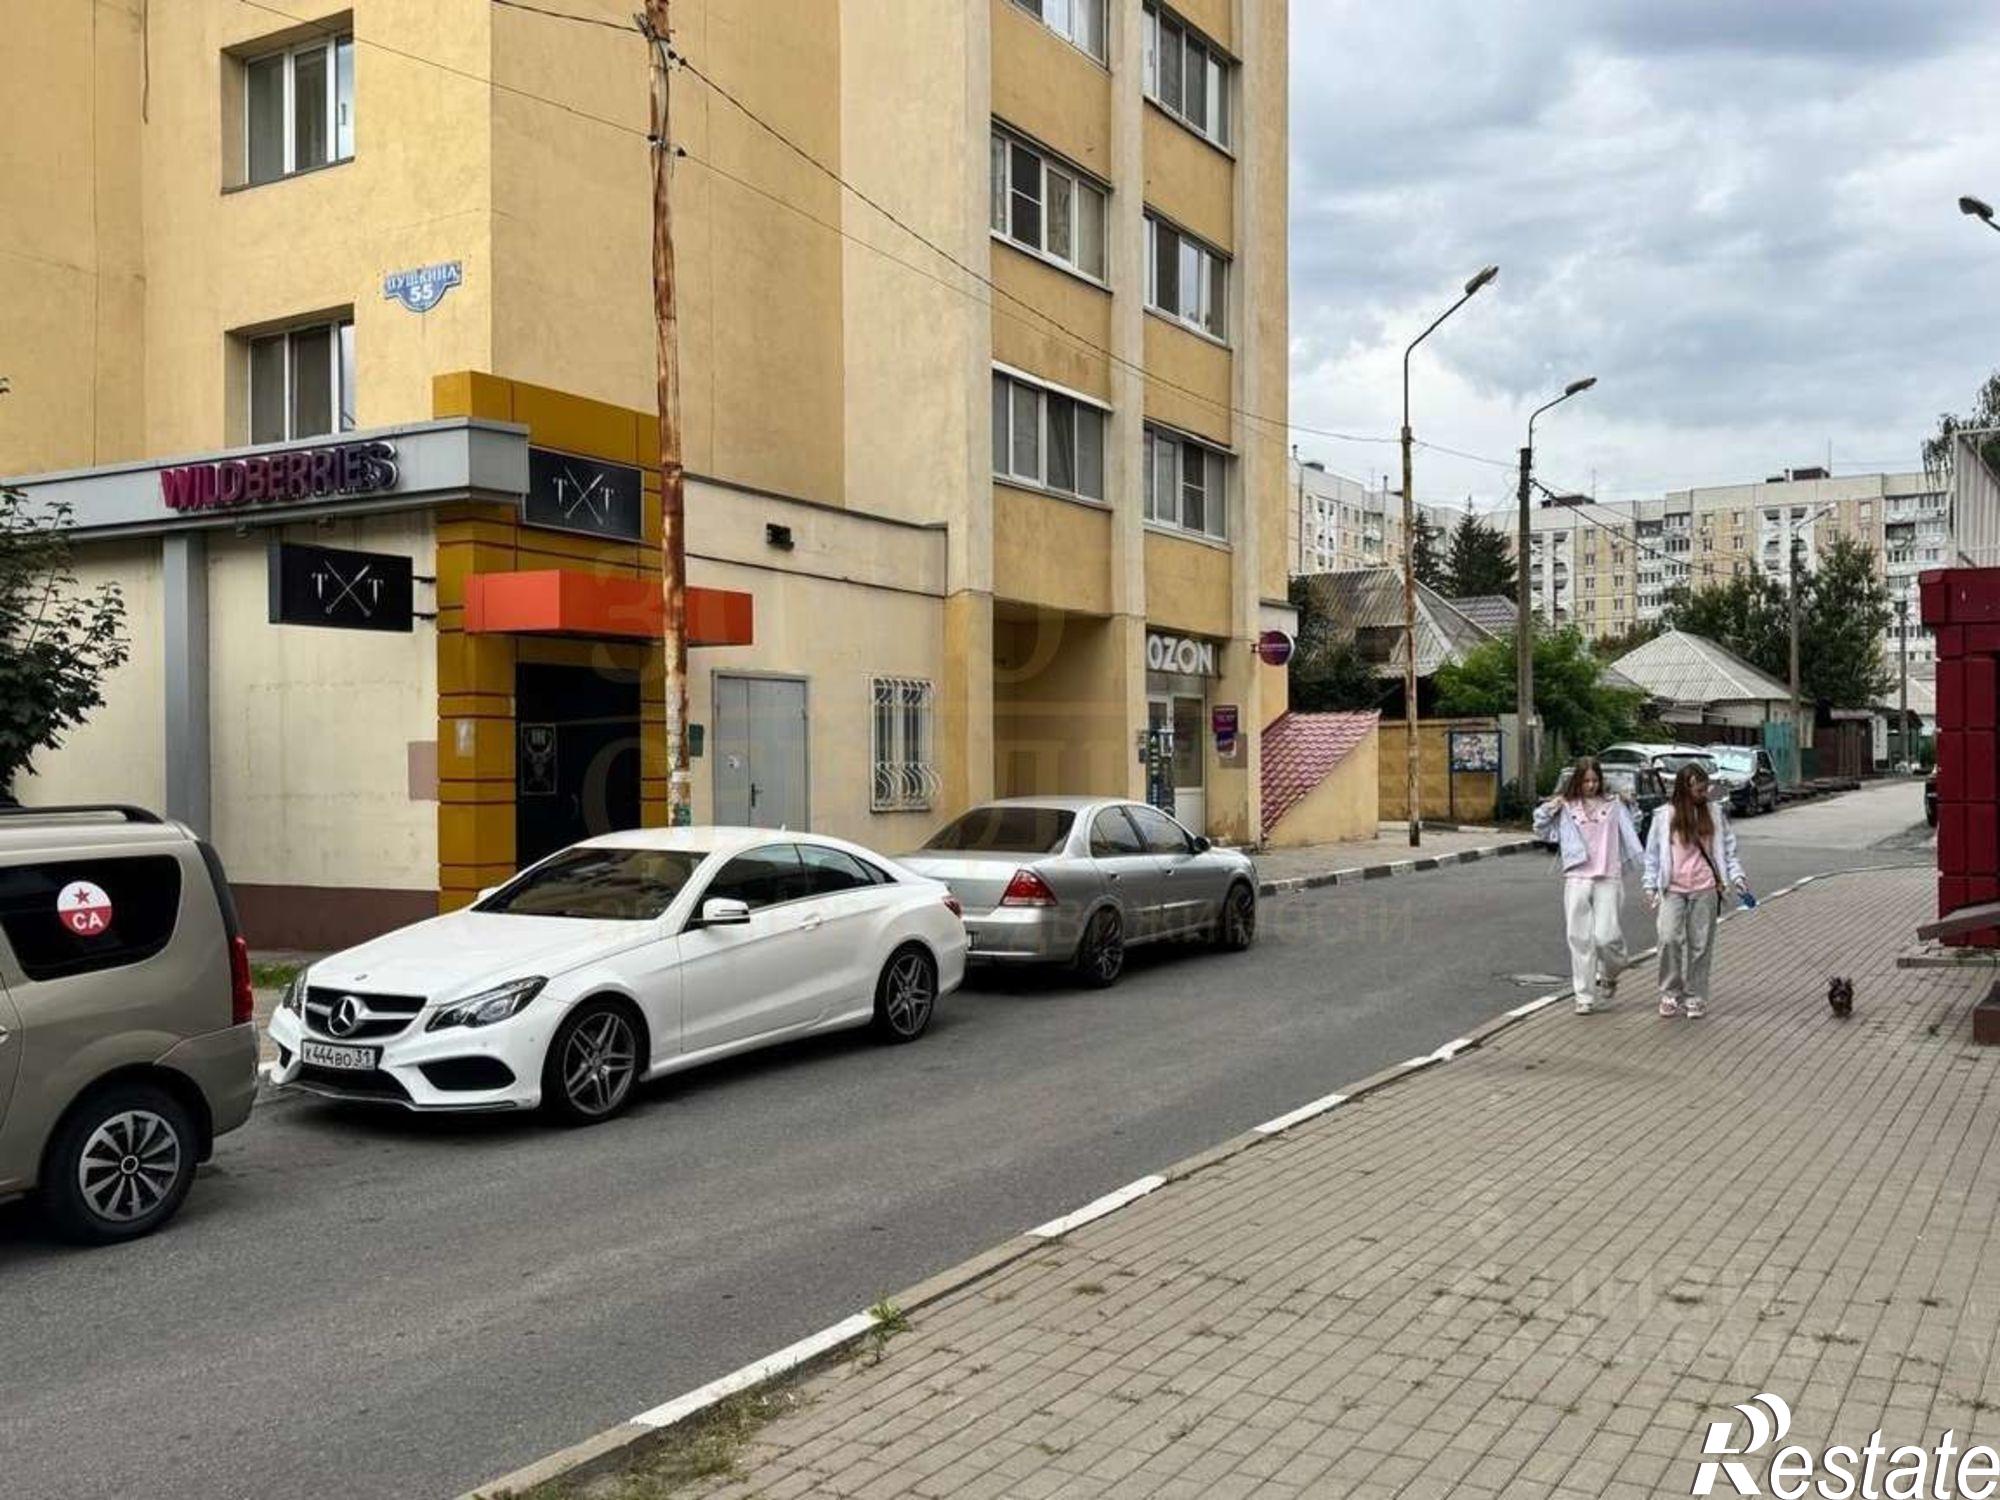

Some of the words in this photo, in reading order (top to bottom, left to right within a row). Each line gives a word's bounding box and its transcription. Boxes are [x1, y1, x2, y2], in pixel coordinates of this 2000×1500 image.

[409, 283, 433, 303] 55
[160, 440, 398, 511] WILDBERRIES
[1147, 634, 1213, 675] OZON
